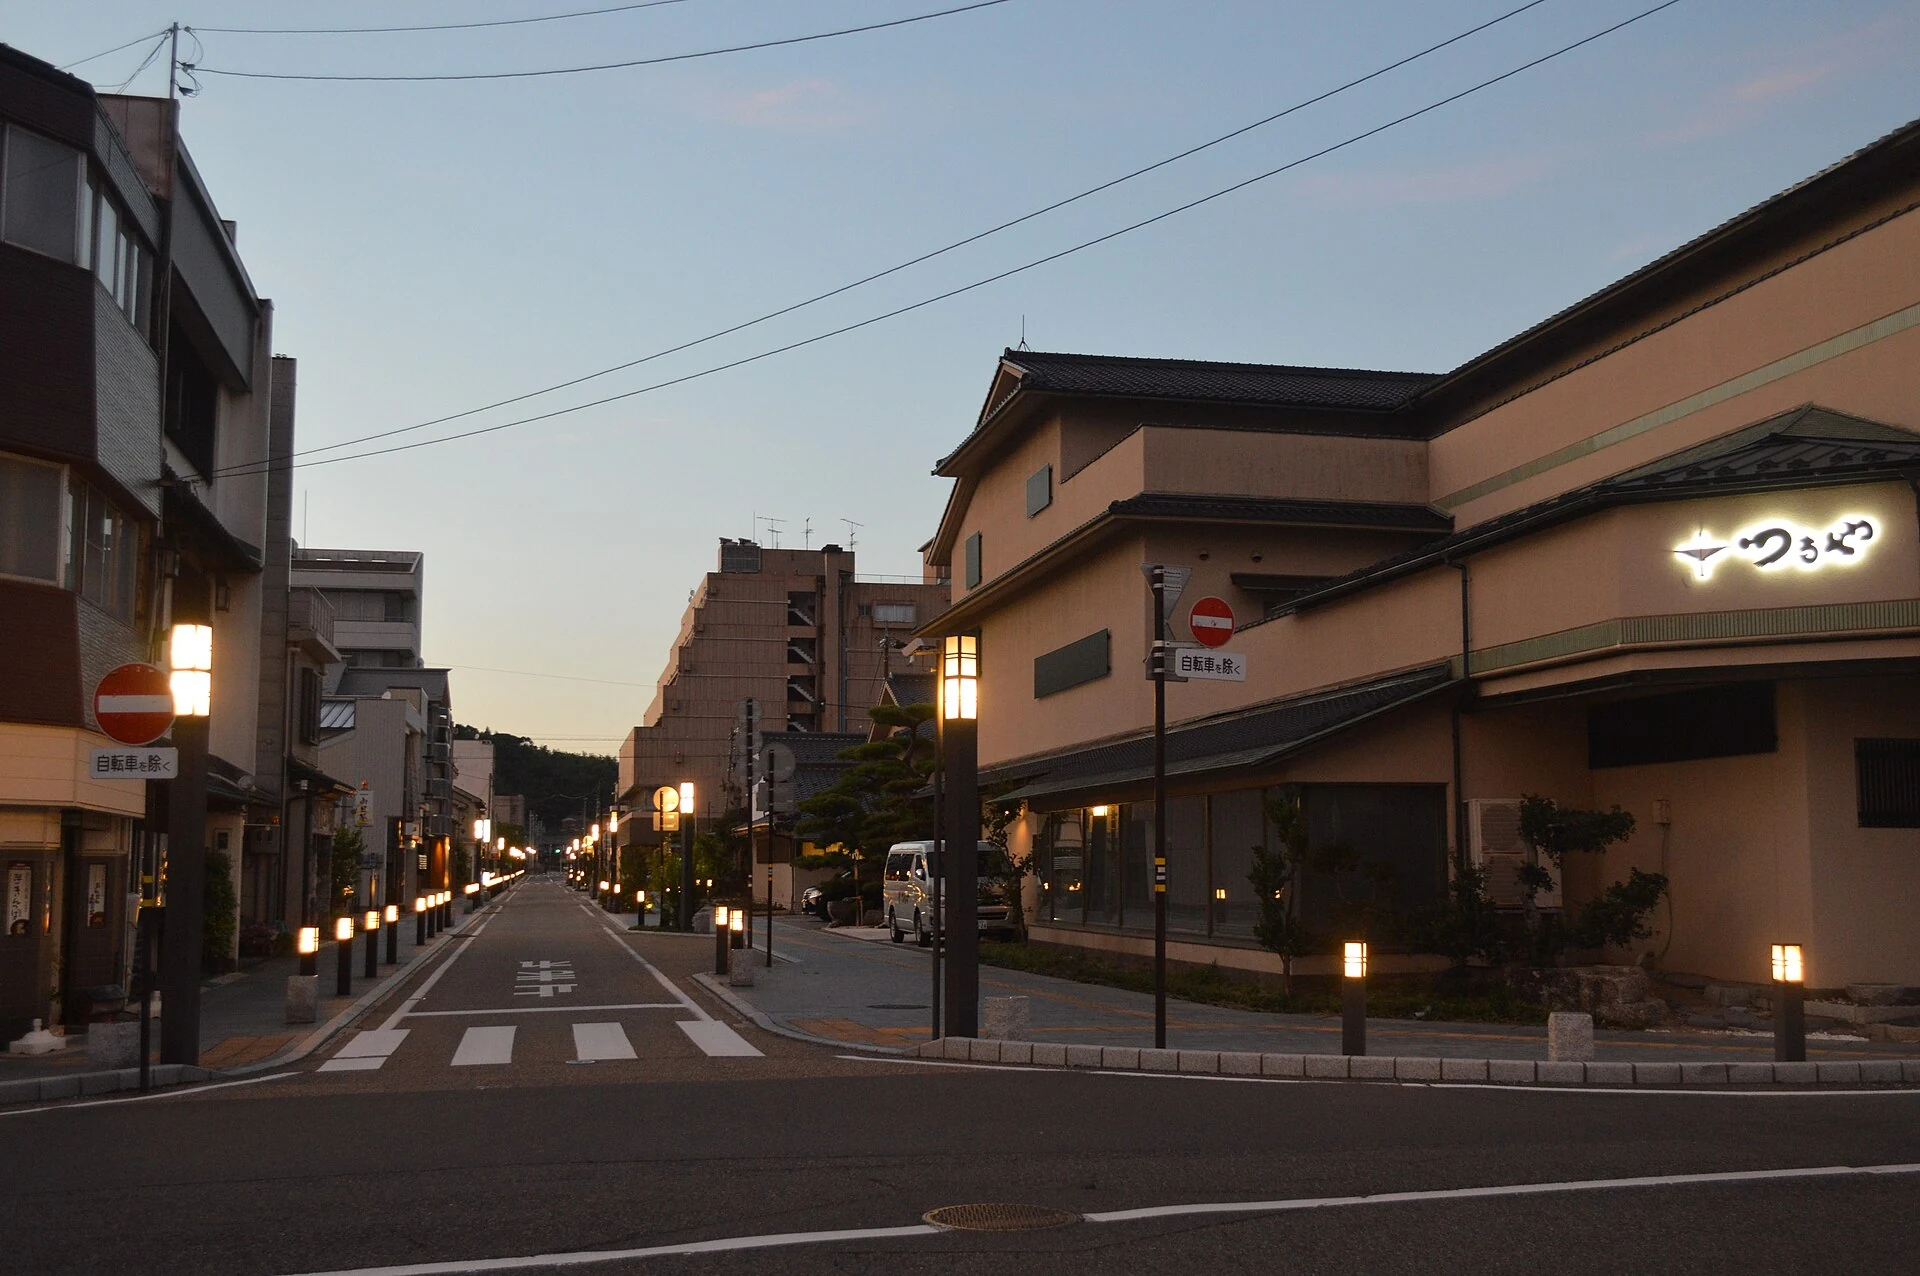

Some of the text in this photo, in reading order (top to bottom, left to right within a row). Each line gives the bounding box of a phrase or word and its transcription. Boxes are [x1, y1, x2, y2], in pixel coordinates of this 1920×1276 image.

[1739, 519, 1874, 568] つるや
[1181, 656, 1241, 675] 自転車を除く
[97, 755, 171, 773] 自転車を除く
